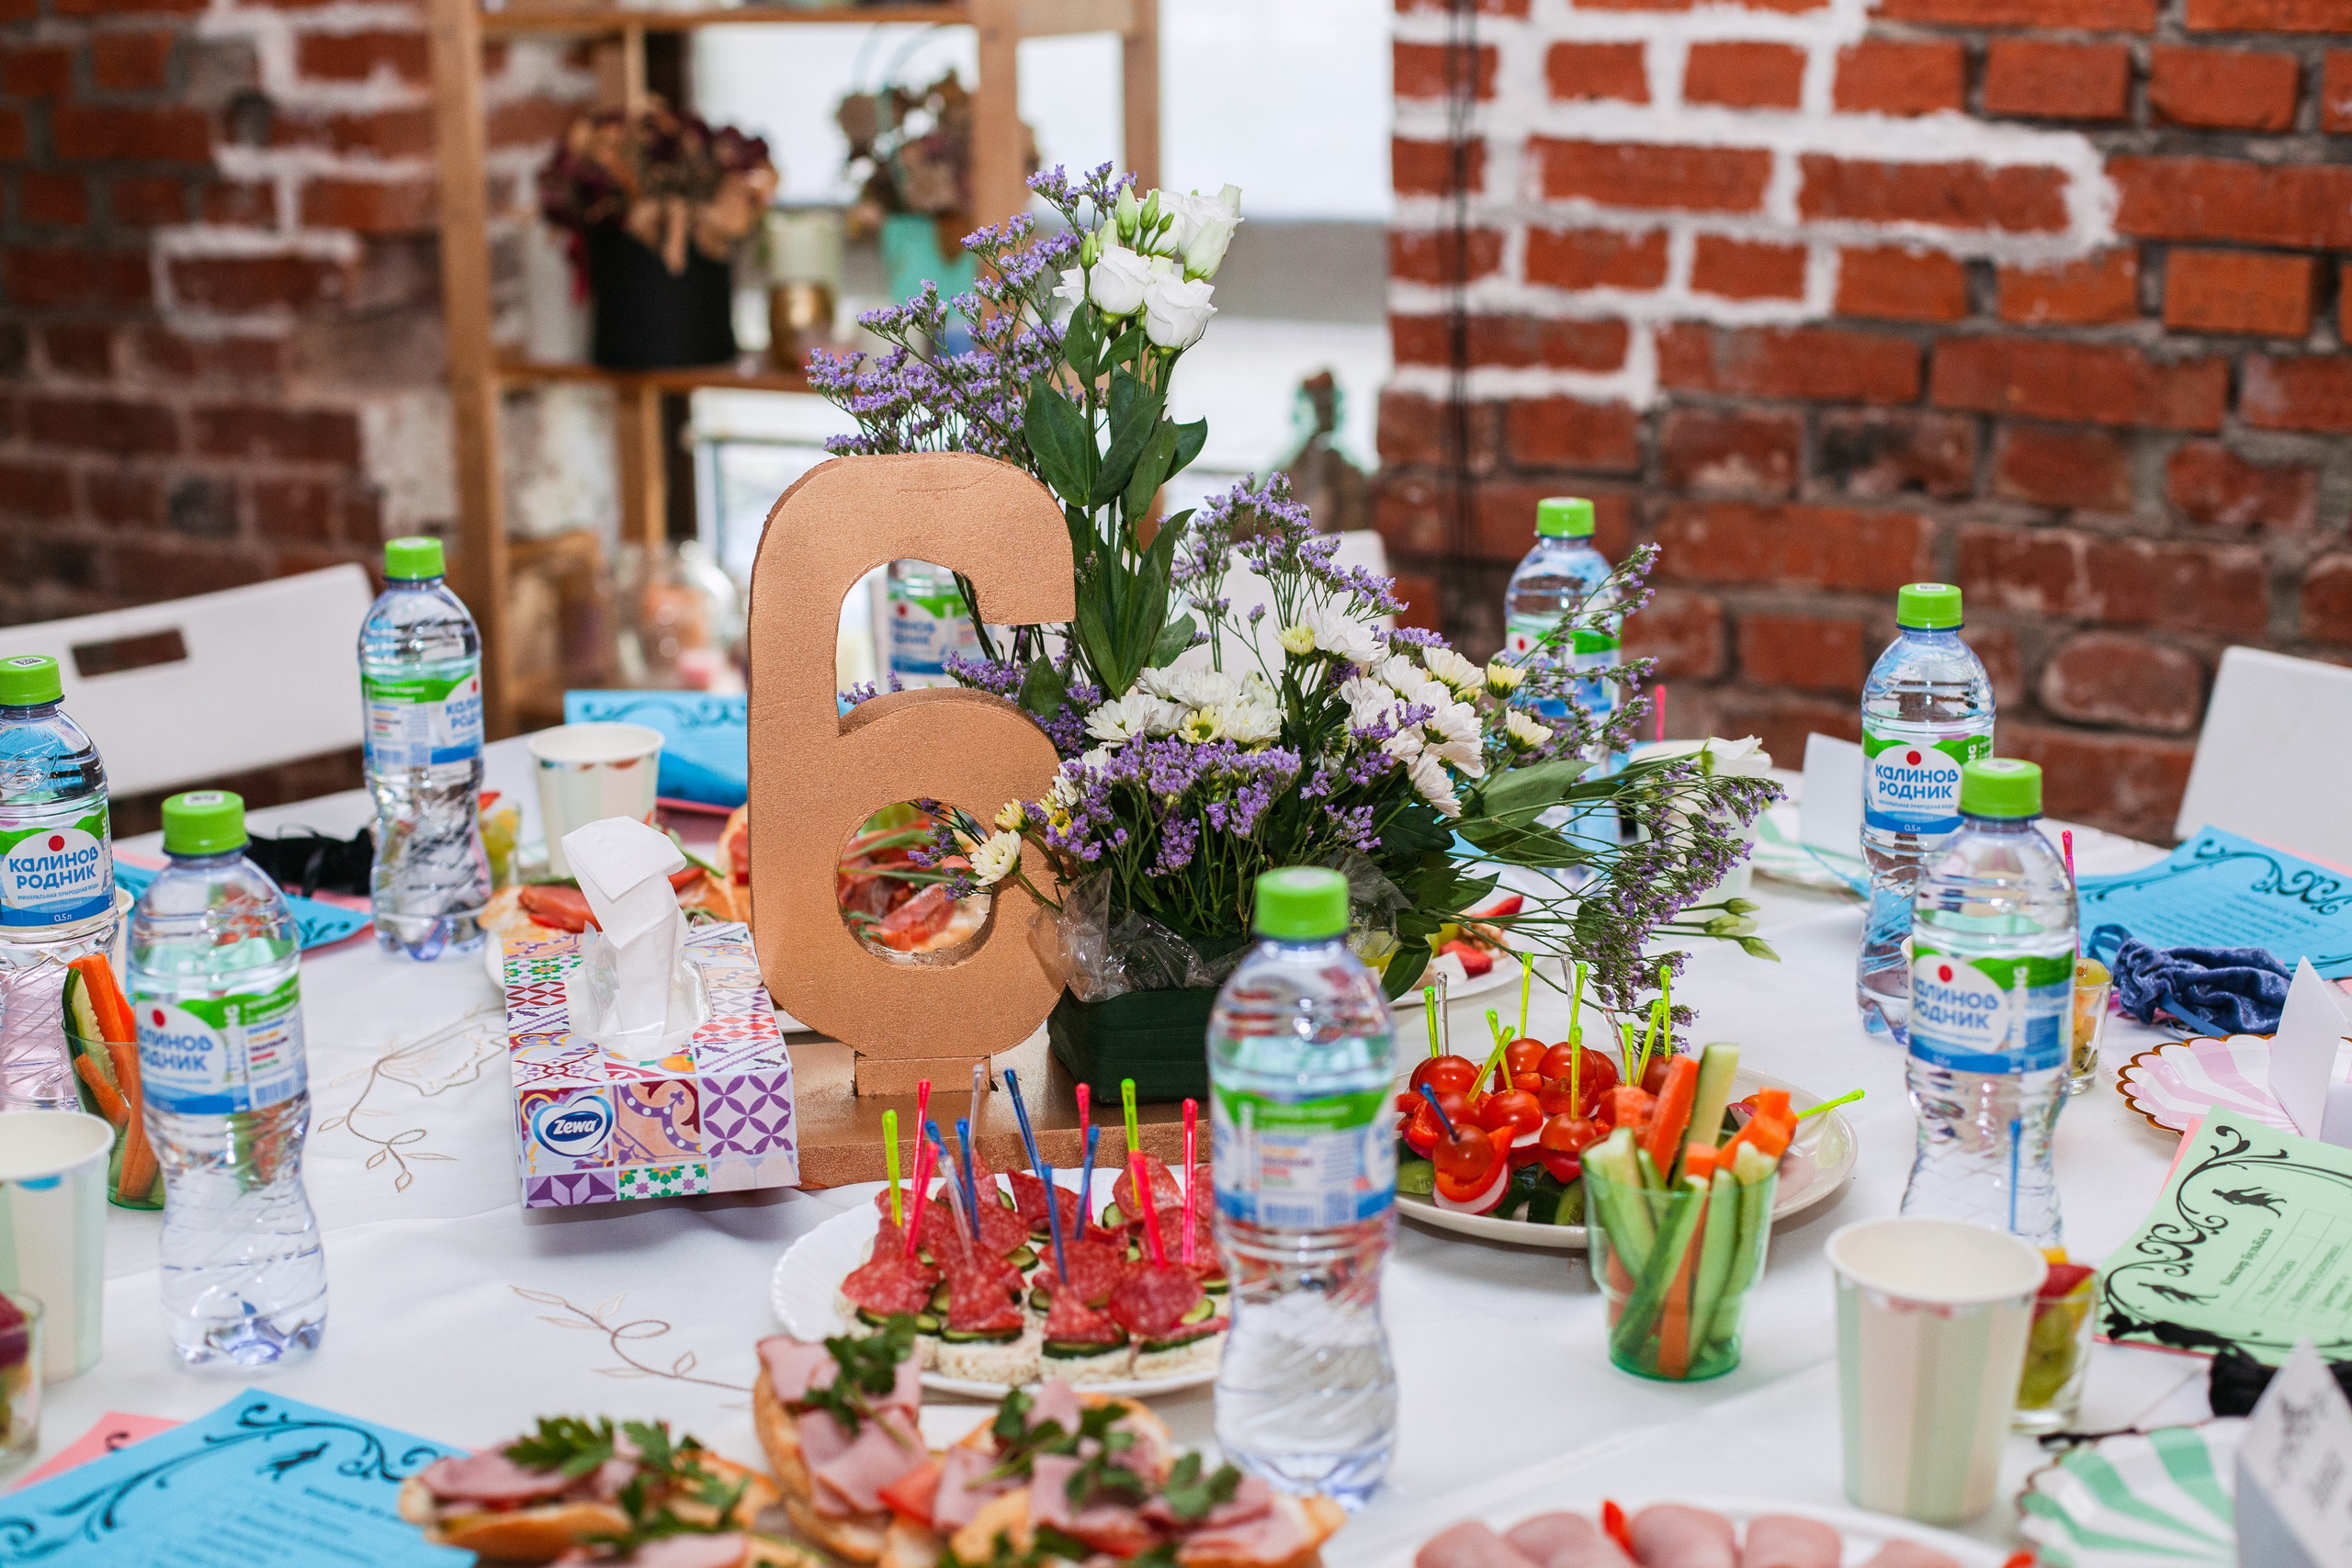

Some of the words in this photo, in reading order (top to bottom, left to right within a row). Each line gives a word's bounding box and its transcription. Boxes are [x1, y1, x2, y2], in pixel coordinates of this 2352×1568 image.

[1879, 781, 1952, 800] РОДНИК
[17, 863, 96, 890] РОДНИК
[553, 1119, 598, 1134] Zewa
